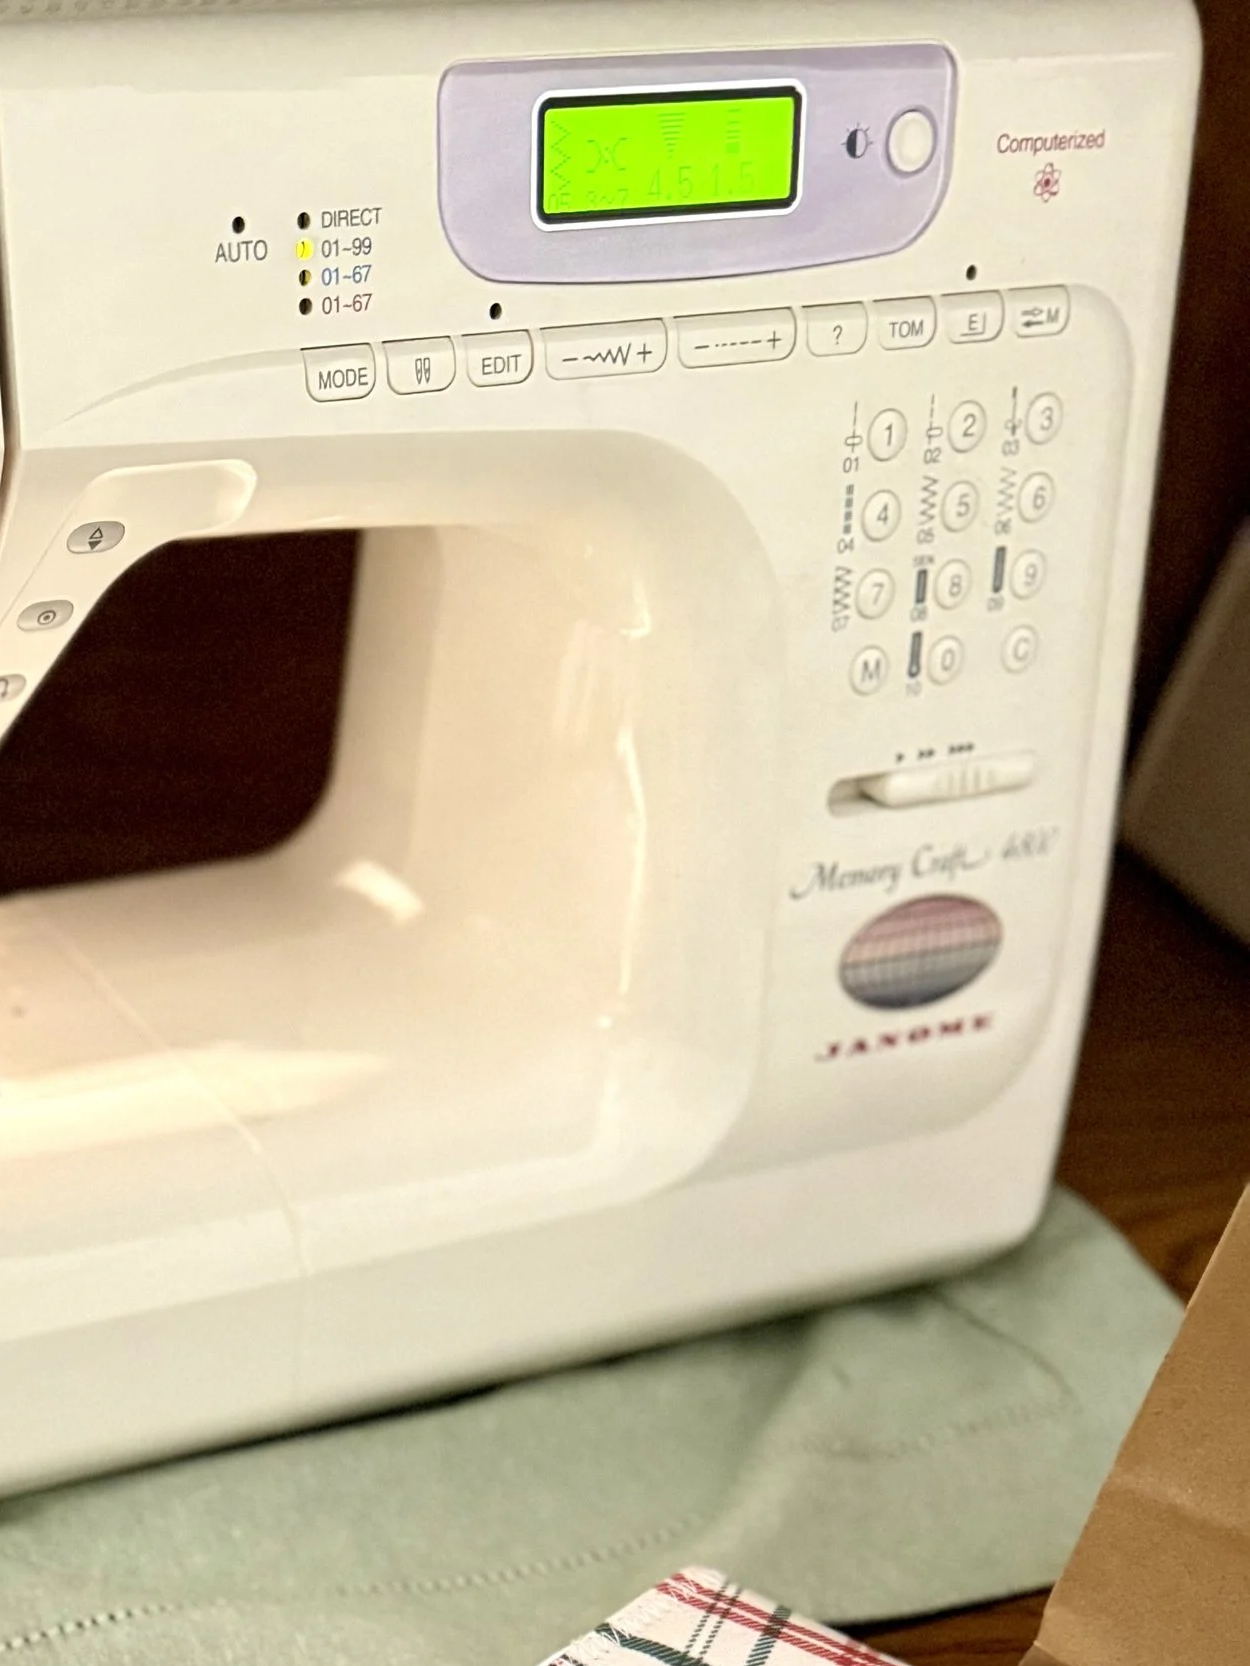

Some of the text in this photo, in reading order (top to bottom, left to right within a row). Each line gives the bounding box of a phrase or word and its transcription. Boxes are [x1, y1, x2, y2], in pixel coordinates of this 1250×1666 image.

[996, 128, 1105, 156] Computerized
[321, 207, 382, 228] DIRECT
[215, 239, 268, 263] AUTO
[889, 320, 924, 338] TOM
[481, 354, 522, 375] EDIT
[318, 367, 369, 390] MODE
[962, 413, 976, 437] 2
[1040, 406, 1053, 432] 3
[885, 424, 893, 446] 1
[843, 456, 860, 473] 01
[956, 494, 970, 518] 5
[1033, 485, 1046, 510] 6
[877, 503, 888, 525] 4
[871, 583, 884, 606] 7
[949, 573, 962, 598] 8
[861, 658, 880, 683] M
[789, 861, 902, 900] Memory
